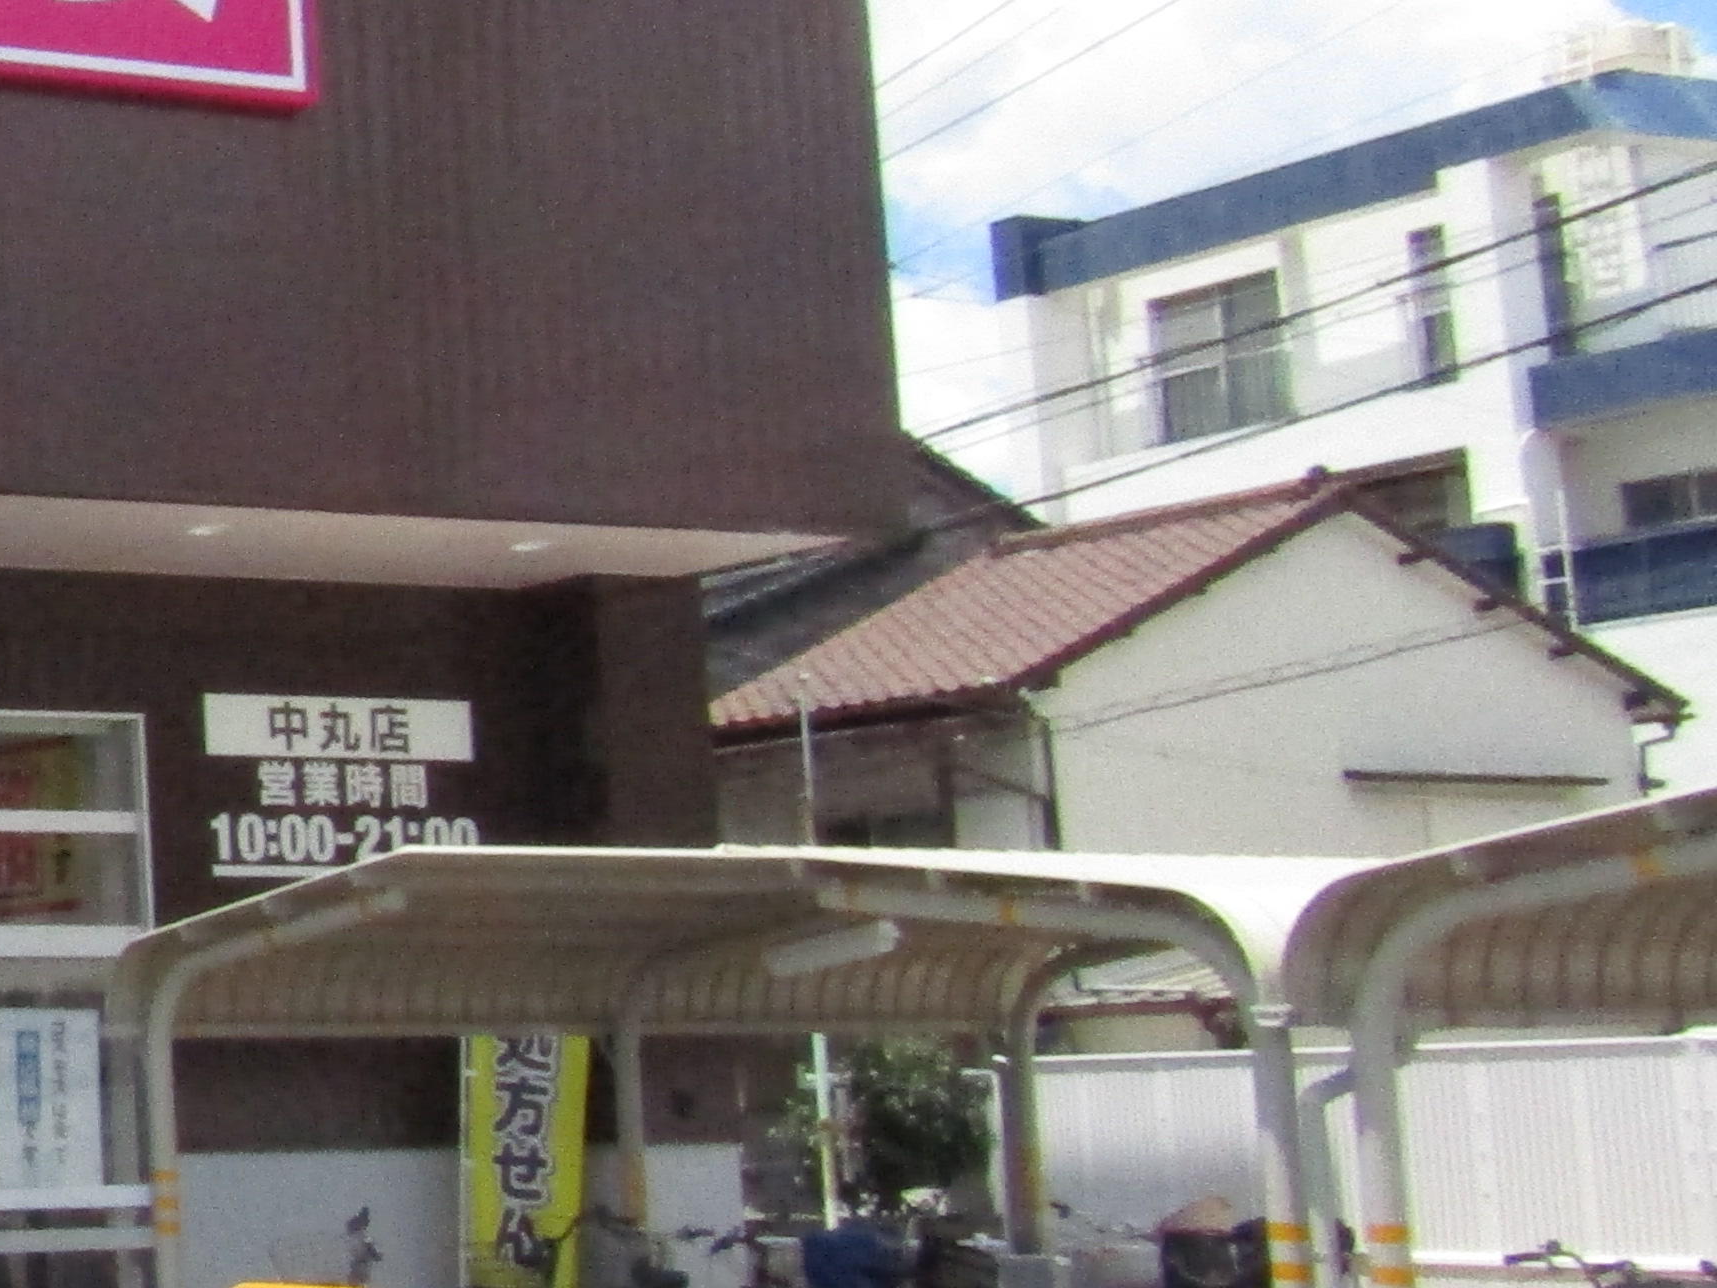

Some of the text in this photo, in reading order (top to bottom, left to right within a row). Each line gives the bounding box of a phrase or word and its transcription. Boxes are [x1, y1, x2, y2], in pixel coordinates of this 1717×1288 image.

[268, 701, 409, 753] 中丸店
[257, 761, 428, 809] 営業時間
